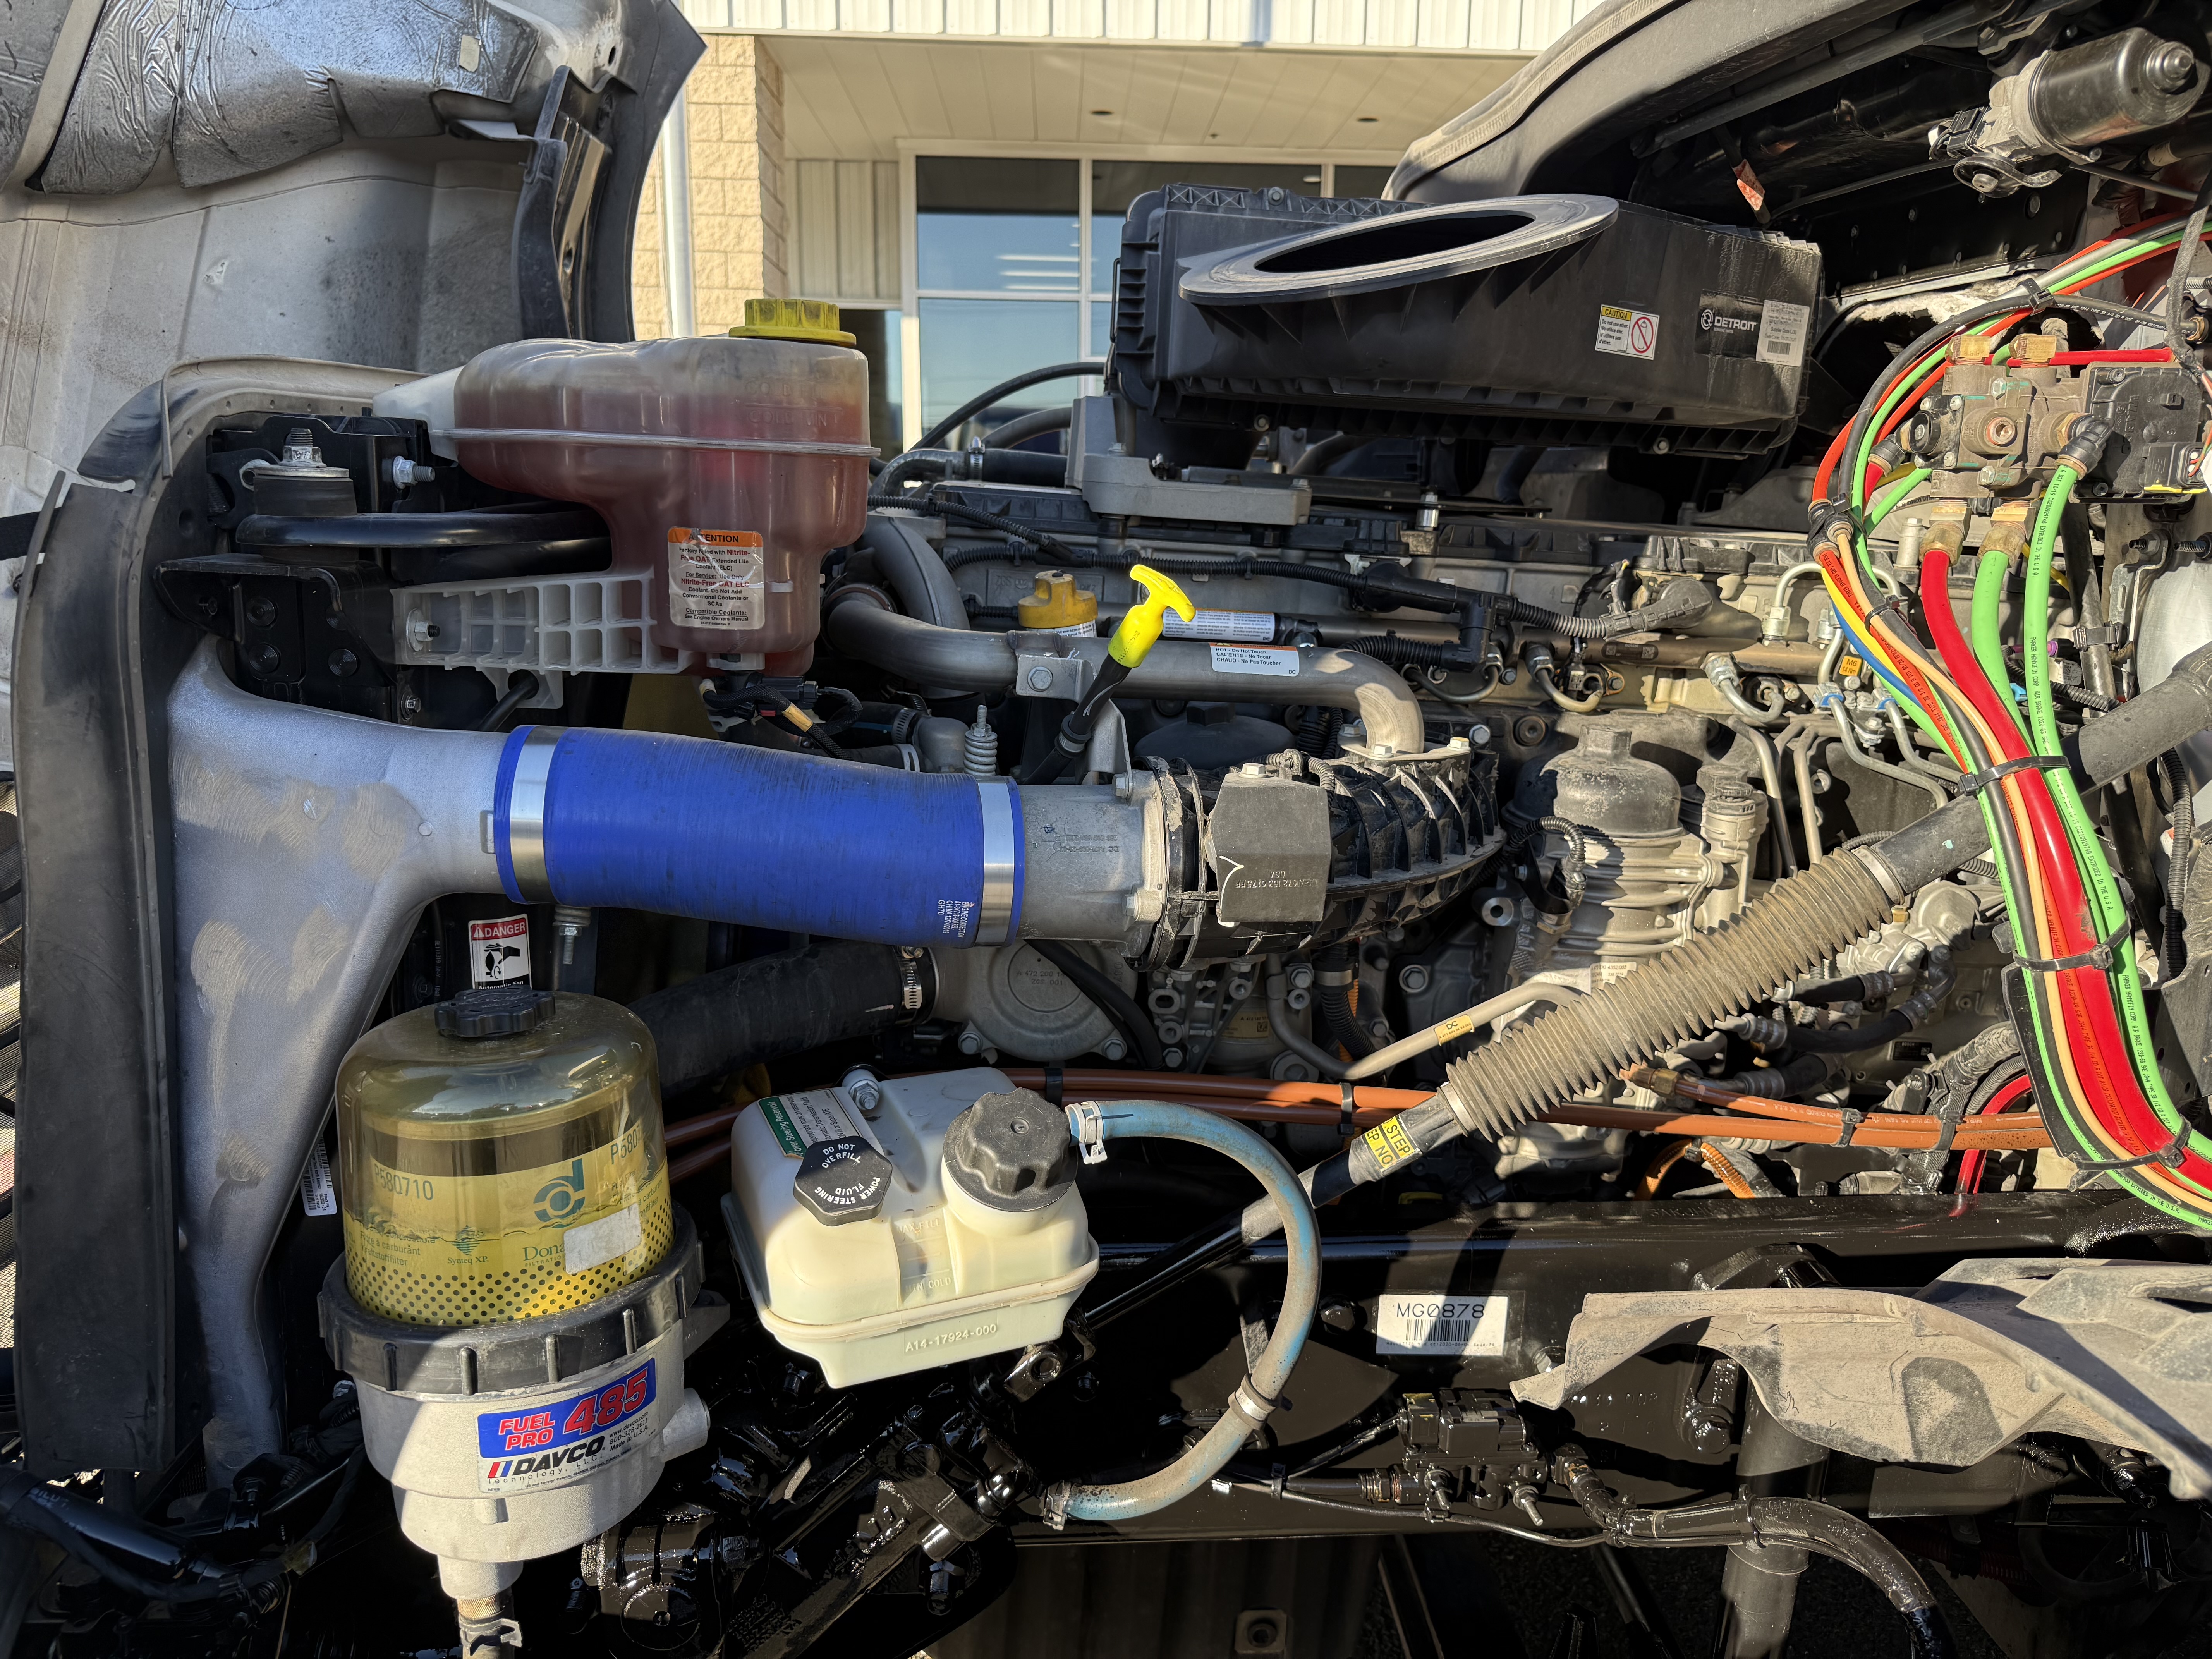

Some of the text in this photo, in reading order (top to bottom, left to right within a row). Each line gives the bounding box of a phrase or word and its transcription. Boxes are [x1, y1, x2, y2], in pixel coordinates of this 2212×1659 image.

[1605, 309, 1628, 319] CAUTION
[1714, 316, 1757, 331] DETROIT
[2037, 526, 2046, 544] EXTRUDED
[2087, 856, 2101, 877] EXTRUDED
[2100, 886, 2108, 894] THE
[945, 900, 953, 914] CHINA
[2103, 896, 2113, 912] U.S.A.
[485, 922, 525, 937] DANGER
[2122, 975, 2131, 989] PARKER
[2126, 991, 2135, 1010] HANNIFIN
[1446, 1021, 1458, 1030] DC
[2145, 1084, 2155, 1092] TYPE
[800, 1096, 810, 1106] Fluid
[768, 1101, 802, 1152] ower Steering Reservoir
[828, 1115, 838, 1125] Super
[1386, 1124, 1411, 1153] STEP
[823, 1146, 835, 1155] DO
[1375, 1145, 1393, 1165] NO
[822, 1152, 861, 1168] OVERFILL
[373, 1163, 433, 1200] P580710
[835, 1183, 864, 1195] FLUID
[814, 1177, 881, 1205] POWER STEERING
[2130, 1182, 2150, 1197] EXTRUDED
[2166, 1202, 2181, 1215] U.S.A.
[896, 1218, 940, 1234] MAX FILL
[382, 1240, 421, 1255] carburant
[929, 1277, 951, 1288] COLD
[1396, 1303, 1485, 1318] MG0878
[905, 1324, 996, 1352] A14-17924-000
[498, 1367, 648, 1435] FUEL 485
[609, 1412, 648, 1438] www.davco.com
[609, 1418, 648, 1445] 800-328-2611
[505, 1428, 553, 1451] PRO
[610, 1440, 625, 1451] Made
[634, 1426, 649, 1438] U.S.A.
[512, 1435, 606, 1476] DAVCO
[487, 1468, 568, 1484] Technology,
